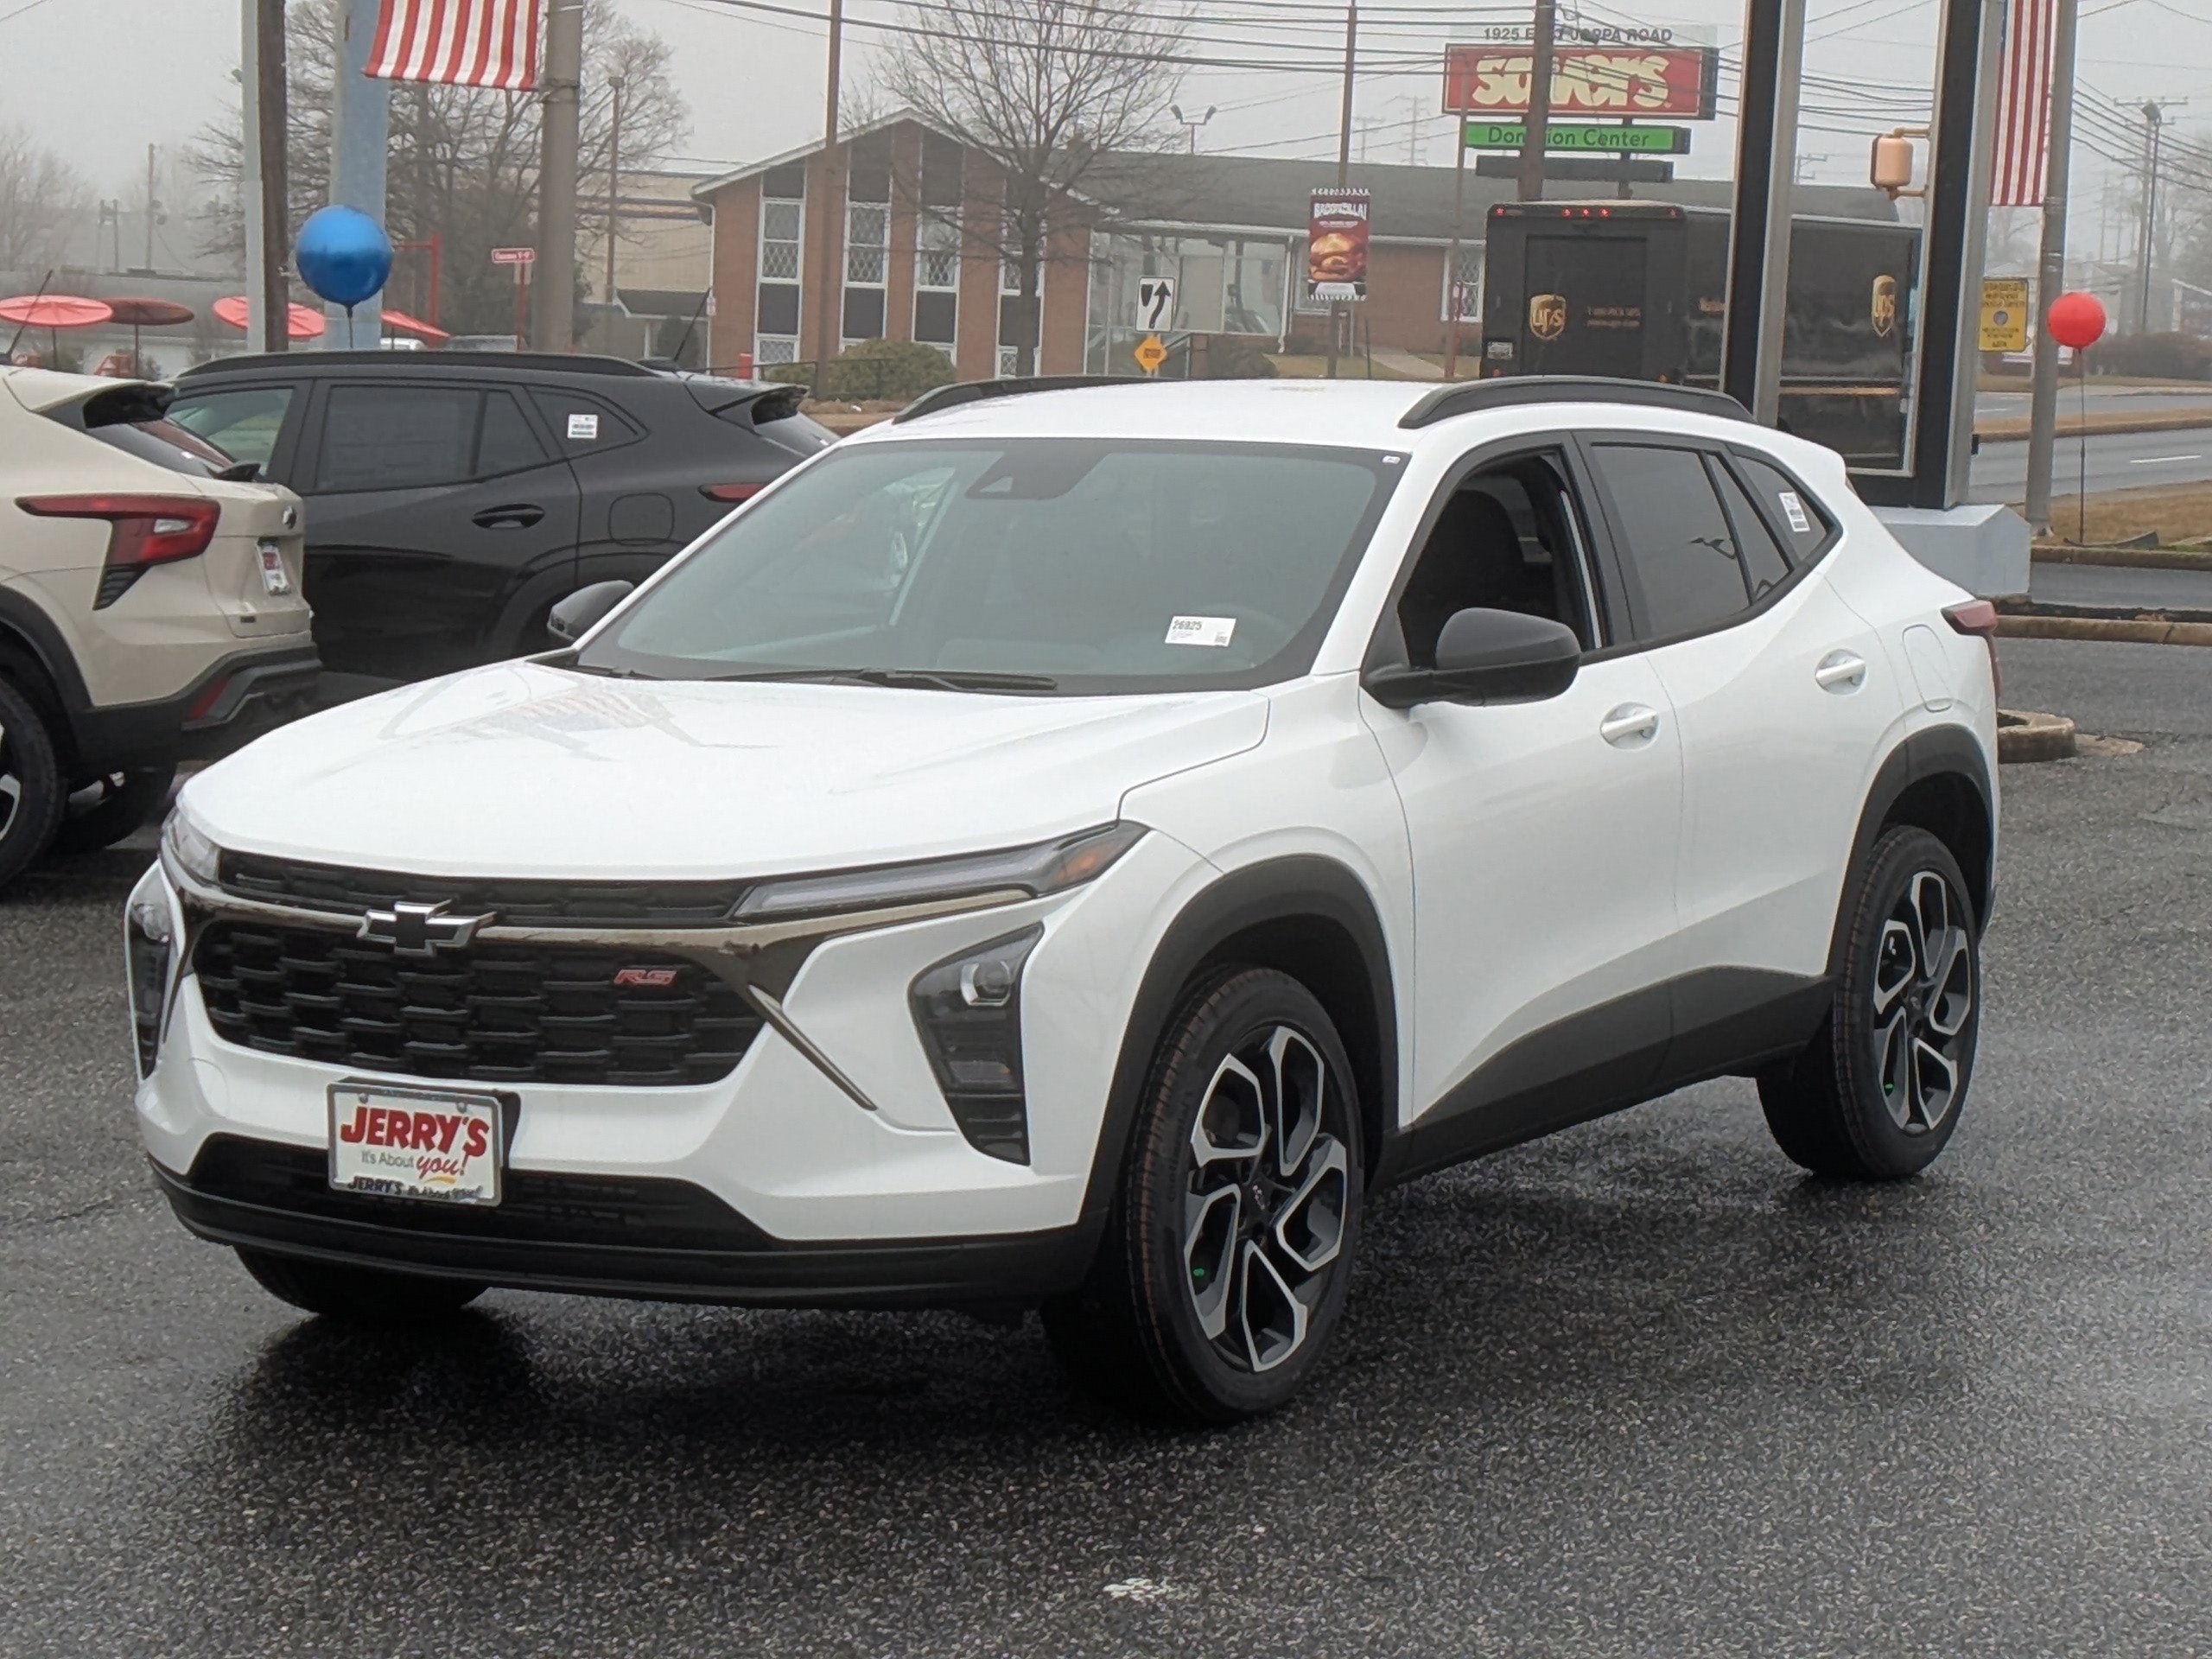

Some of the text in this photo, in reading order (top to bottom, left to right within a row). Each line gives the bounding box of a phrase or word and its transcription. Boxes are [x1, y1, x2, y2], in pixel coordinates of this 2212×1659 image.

[1484, 29, 1520, 41] 1925
[1628, 29, 1672, 41] ROAD
[1583, 129, 1649, 147] Center
[613, 969, 677, 984] RS
[340, 1106, 490, 1158] JERRY'S
[361, 1150, 469, 1180] It's About you!
